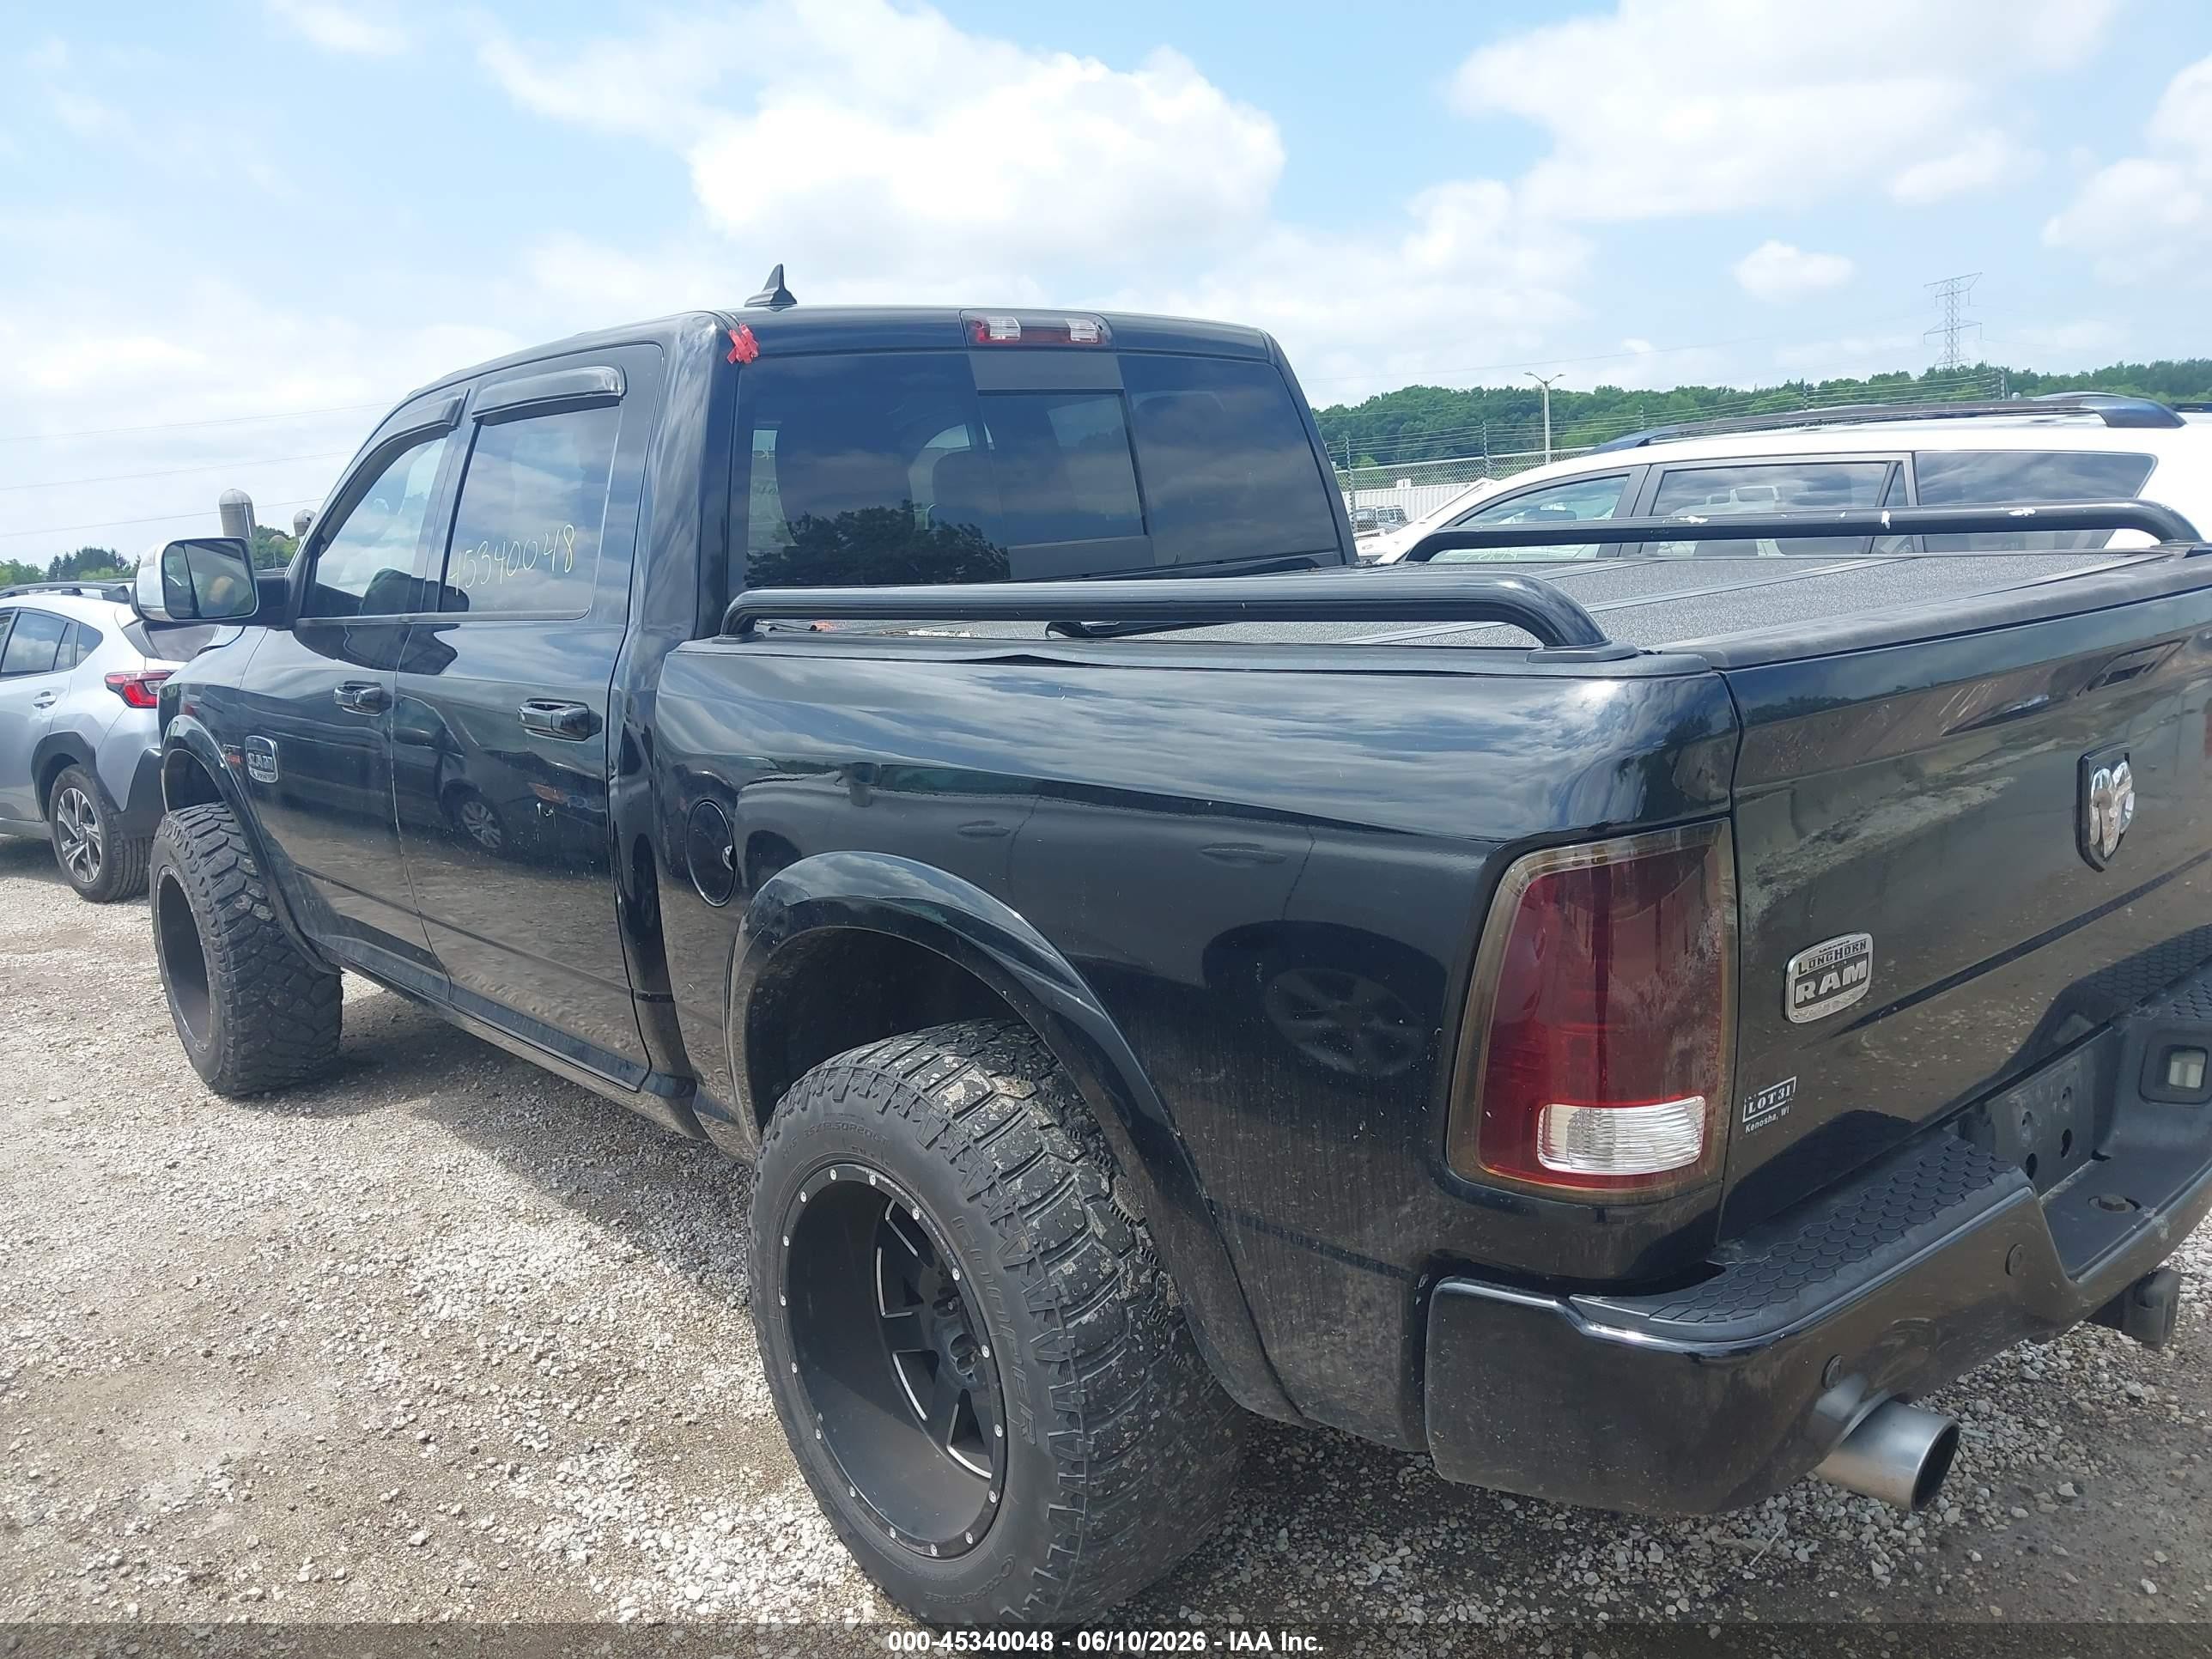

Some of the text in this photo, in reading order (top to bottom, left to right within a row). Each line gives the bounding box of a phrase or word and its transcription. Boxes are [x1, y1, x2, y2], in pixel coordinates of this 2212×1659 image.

[449, 524, 576, 596] 45340048
[1798, 940, 1867, 975] LONGHORN
[1796, 959, 1868, 1004] RAM
